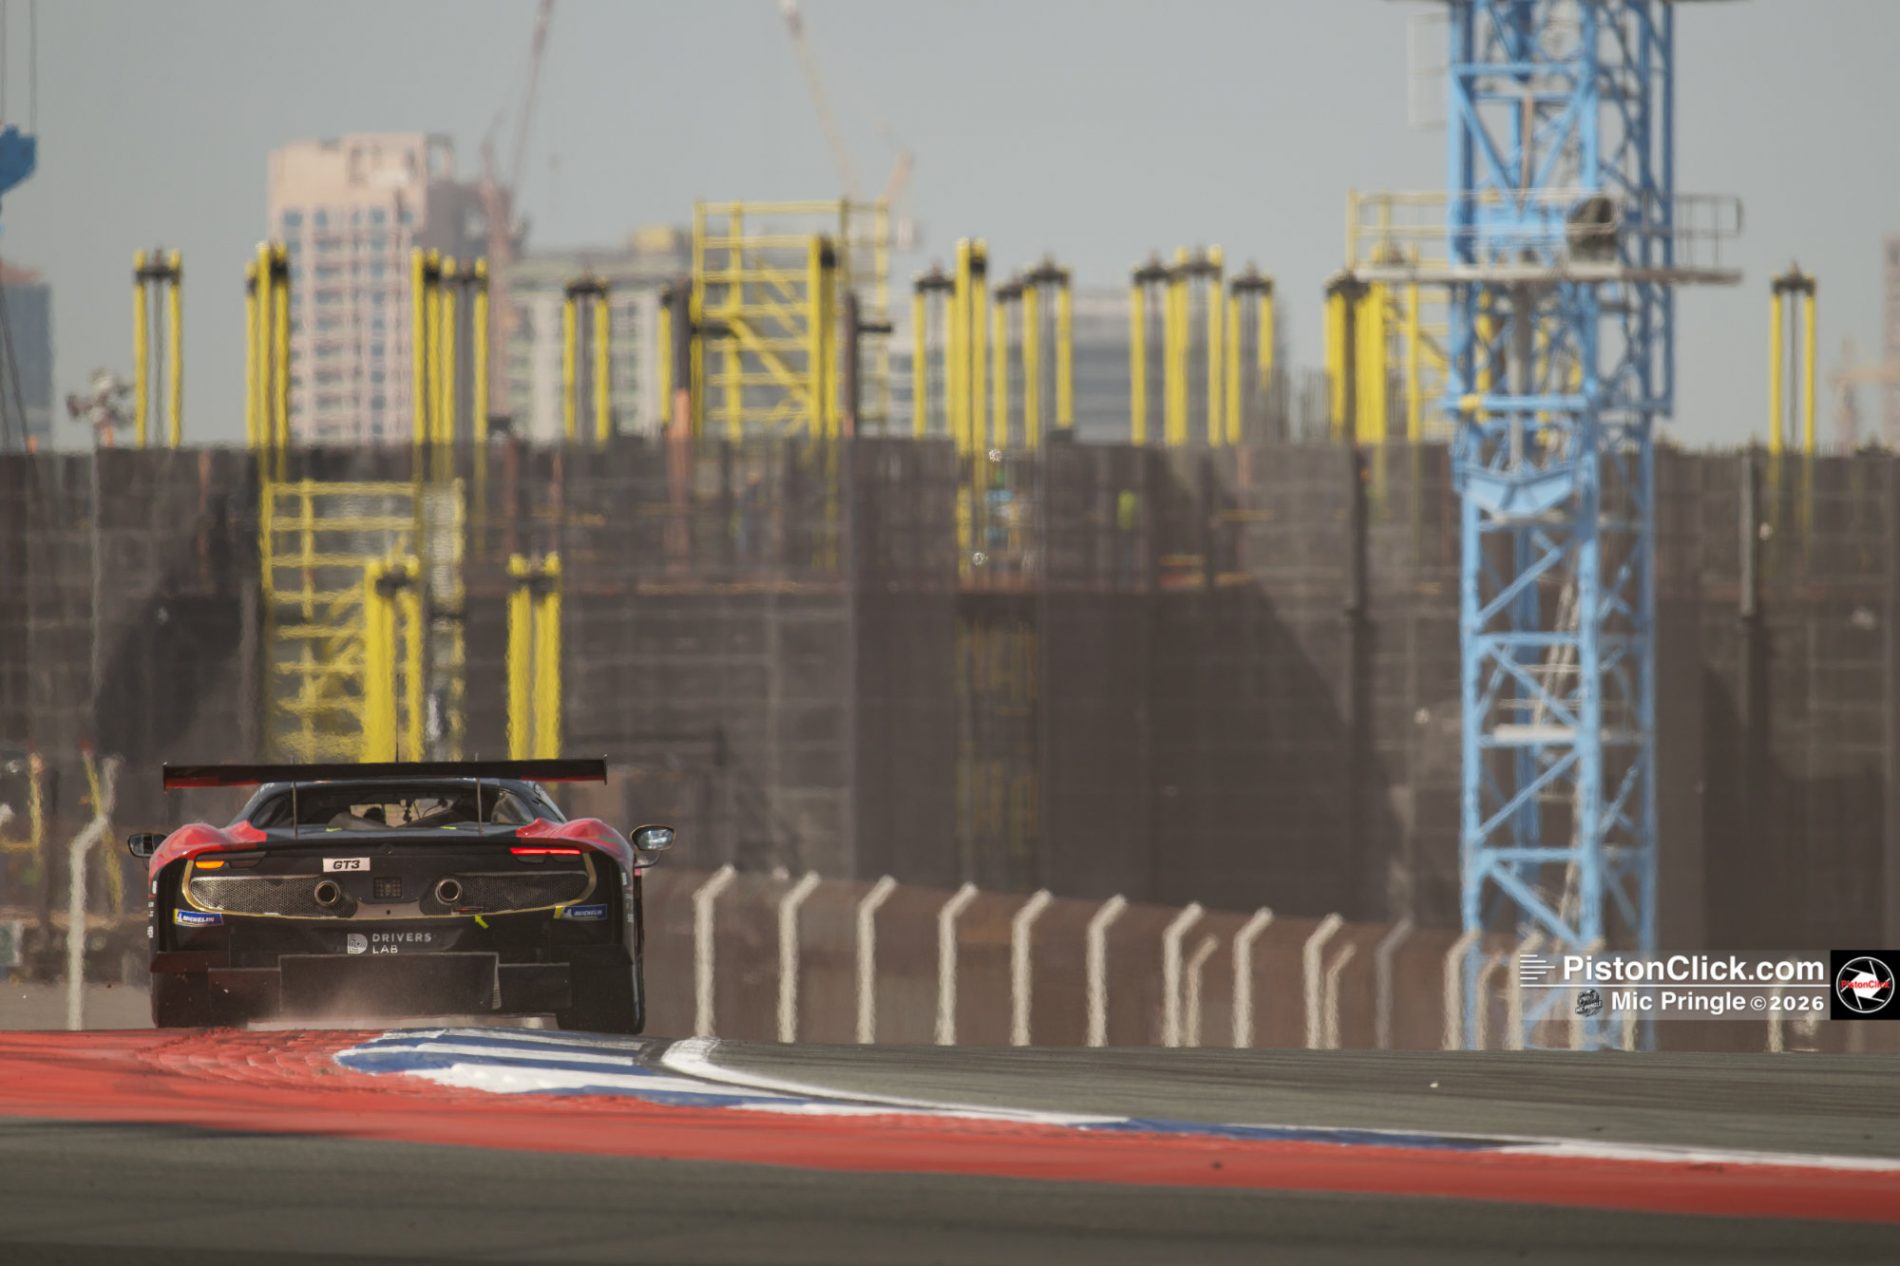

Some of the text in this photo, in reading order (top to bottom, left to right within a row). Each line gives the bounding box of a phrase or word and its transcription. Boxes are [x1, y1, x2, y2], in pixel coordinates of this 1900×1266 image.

[333, 860, 360, 869] GT3
[372, 932, 432, 942] DRIVERS
[372, 944, 398, 954] LAB
